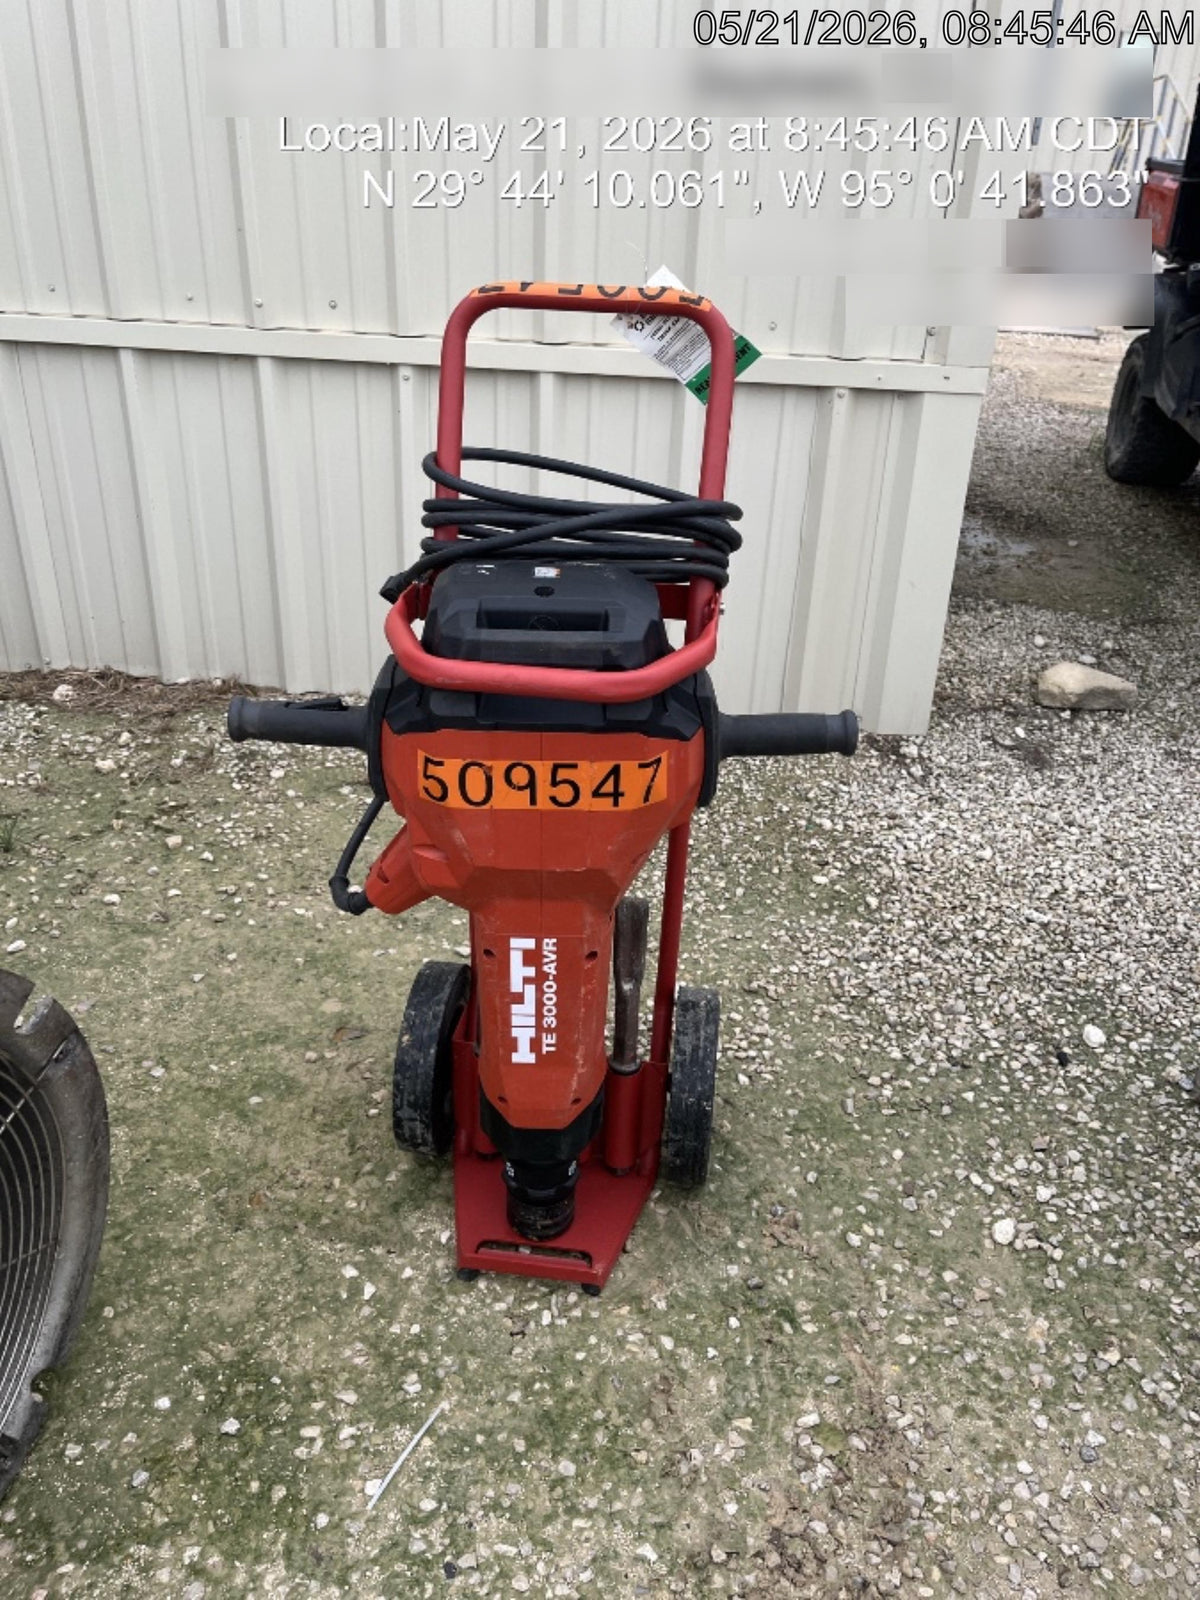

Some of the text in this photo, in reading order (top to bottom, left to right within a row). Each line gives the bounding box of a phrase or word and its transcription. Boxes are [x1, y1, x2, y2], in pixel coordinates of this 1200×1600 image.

[422, 755, 662, 808] 509547
[510, 937, 536, 1064] HILTI
[542, 938, 558, 1055] TE 3000-AVR
